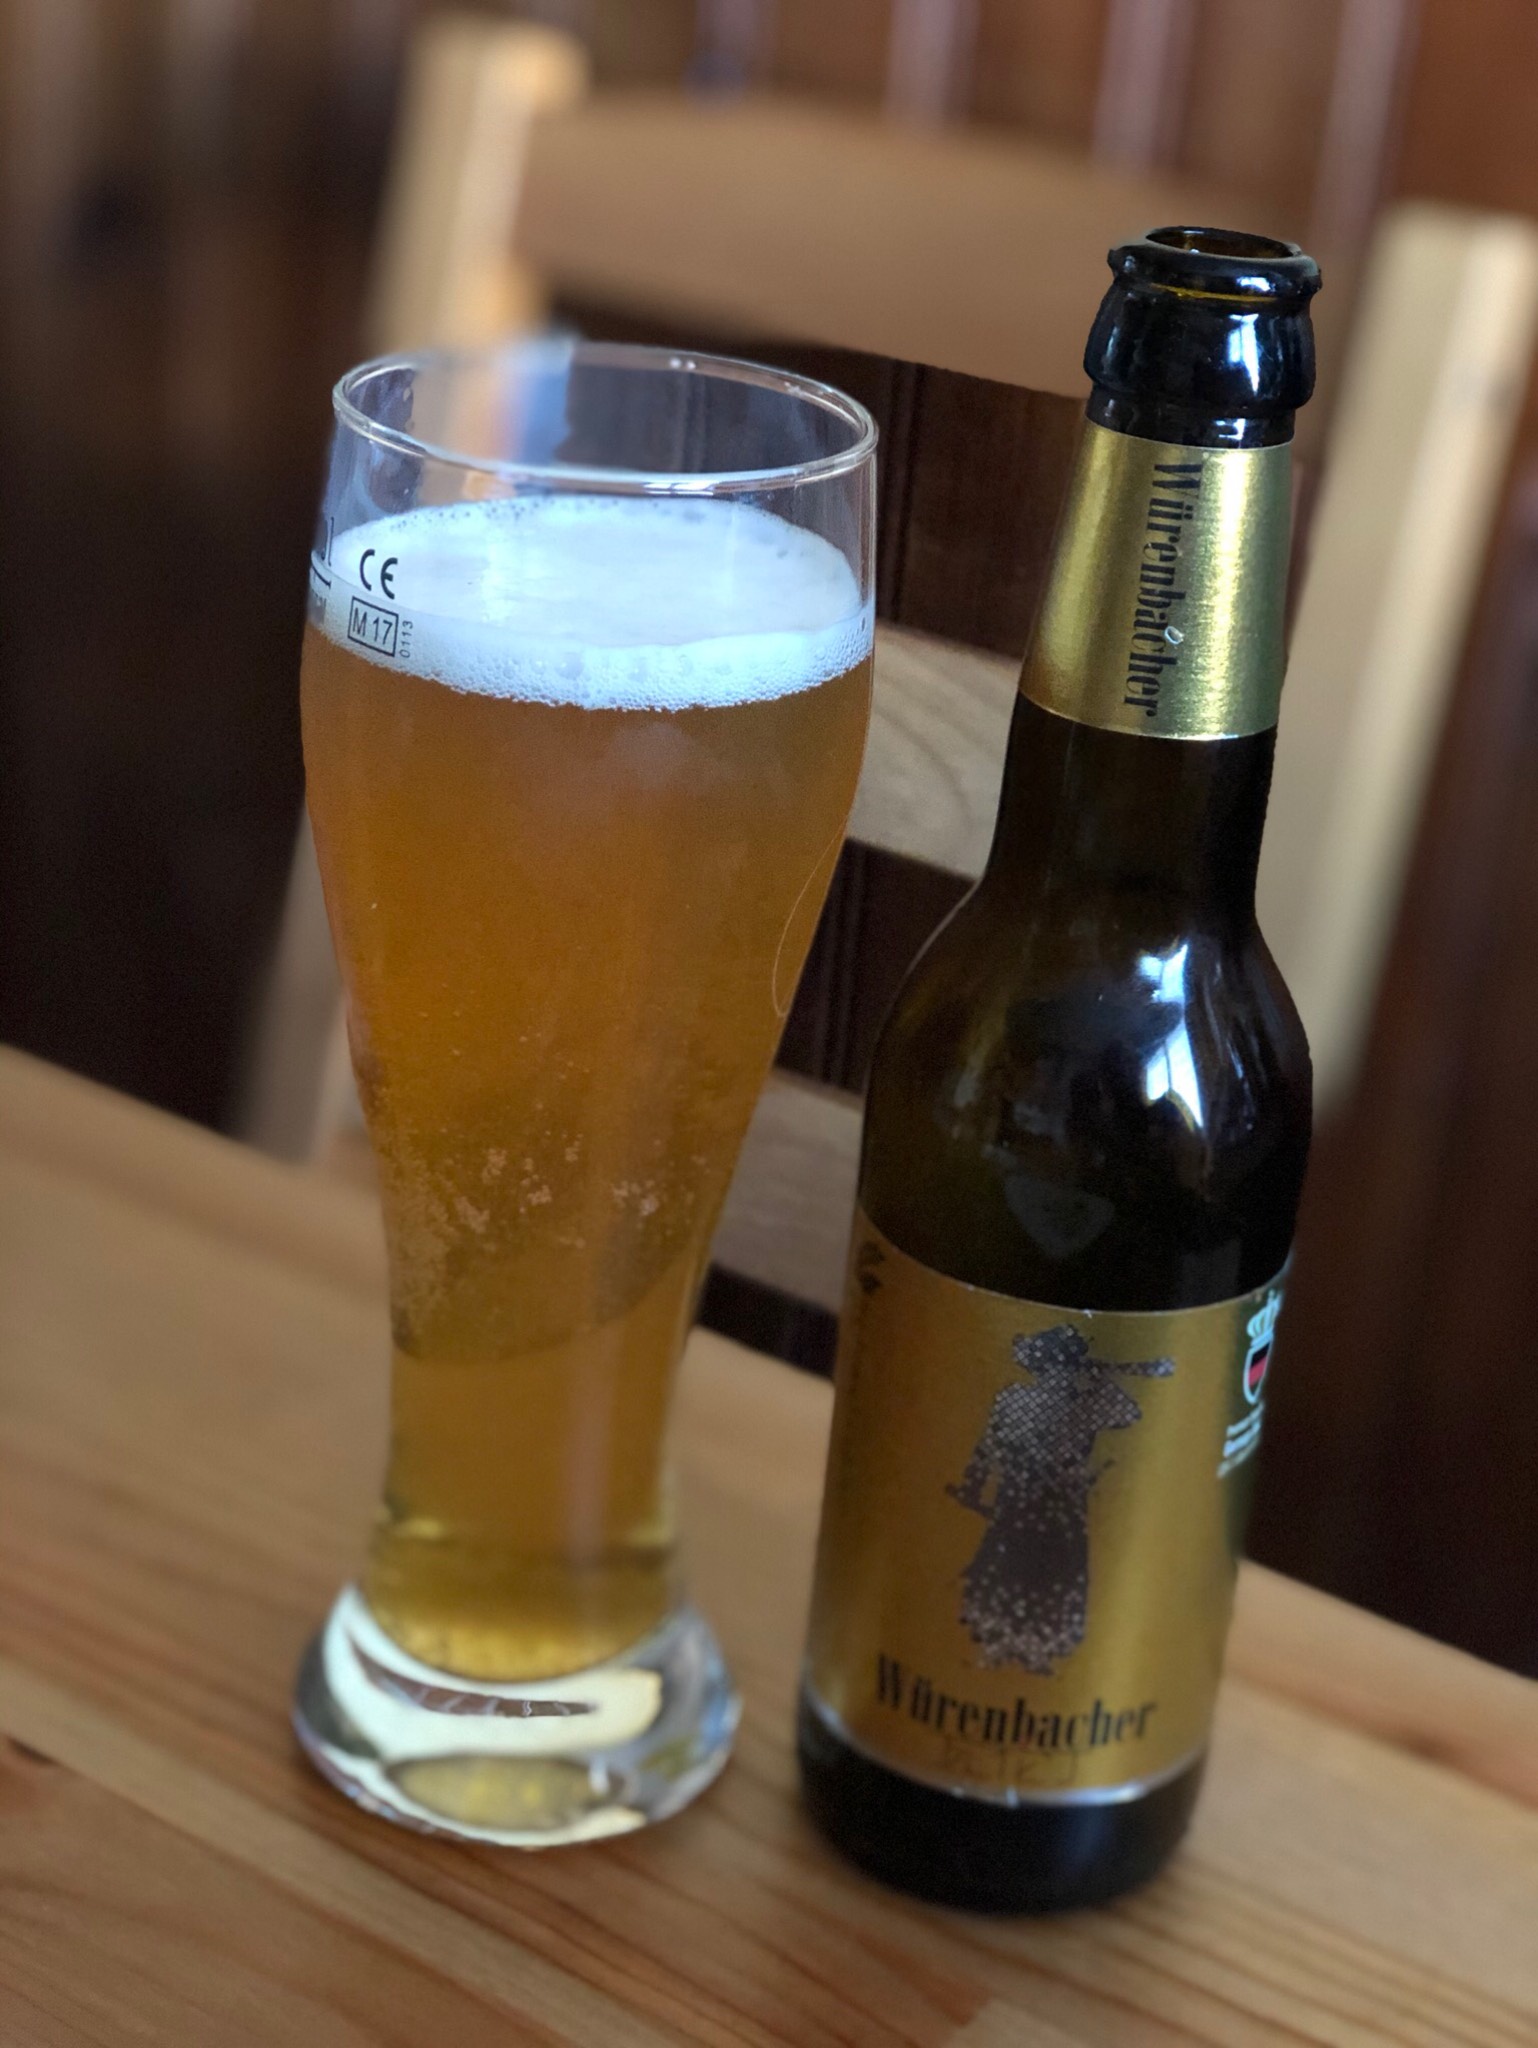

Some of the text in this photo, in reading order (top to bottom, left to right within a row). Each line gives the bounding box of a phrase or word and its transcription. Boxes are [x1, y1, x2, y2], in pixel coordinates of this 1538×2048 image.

[359, 548, 398, 600] CE
[1123, 463, 1203, 718] Würenbacher
[400, 620, 413, 658] 0113
[876, 1653, 1156, 1749] Würenbacher
